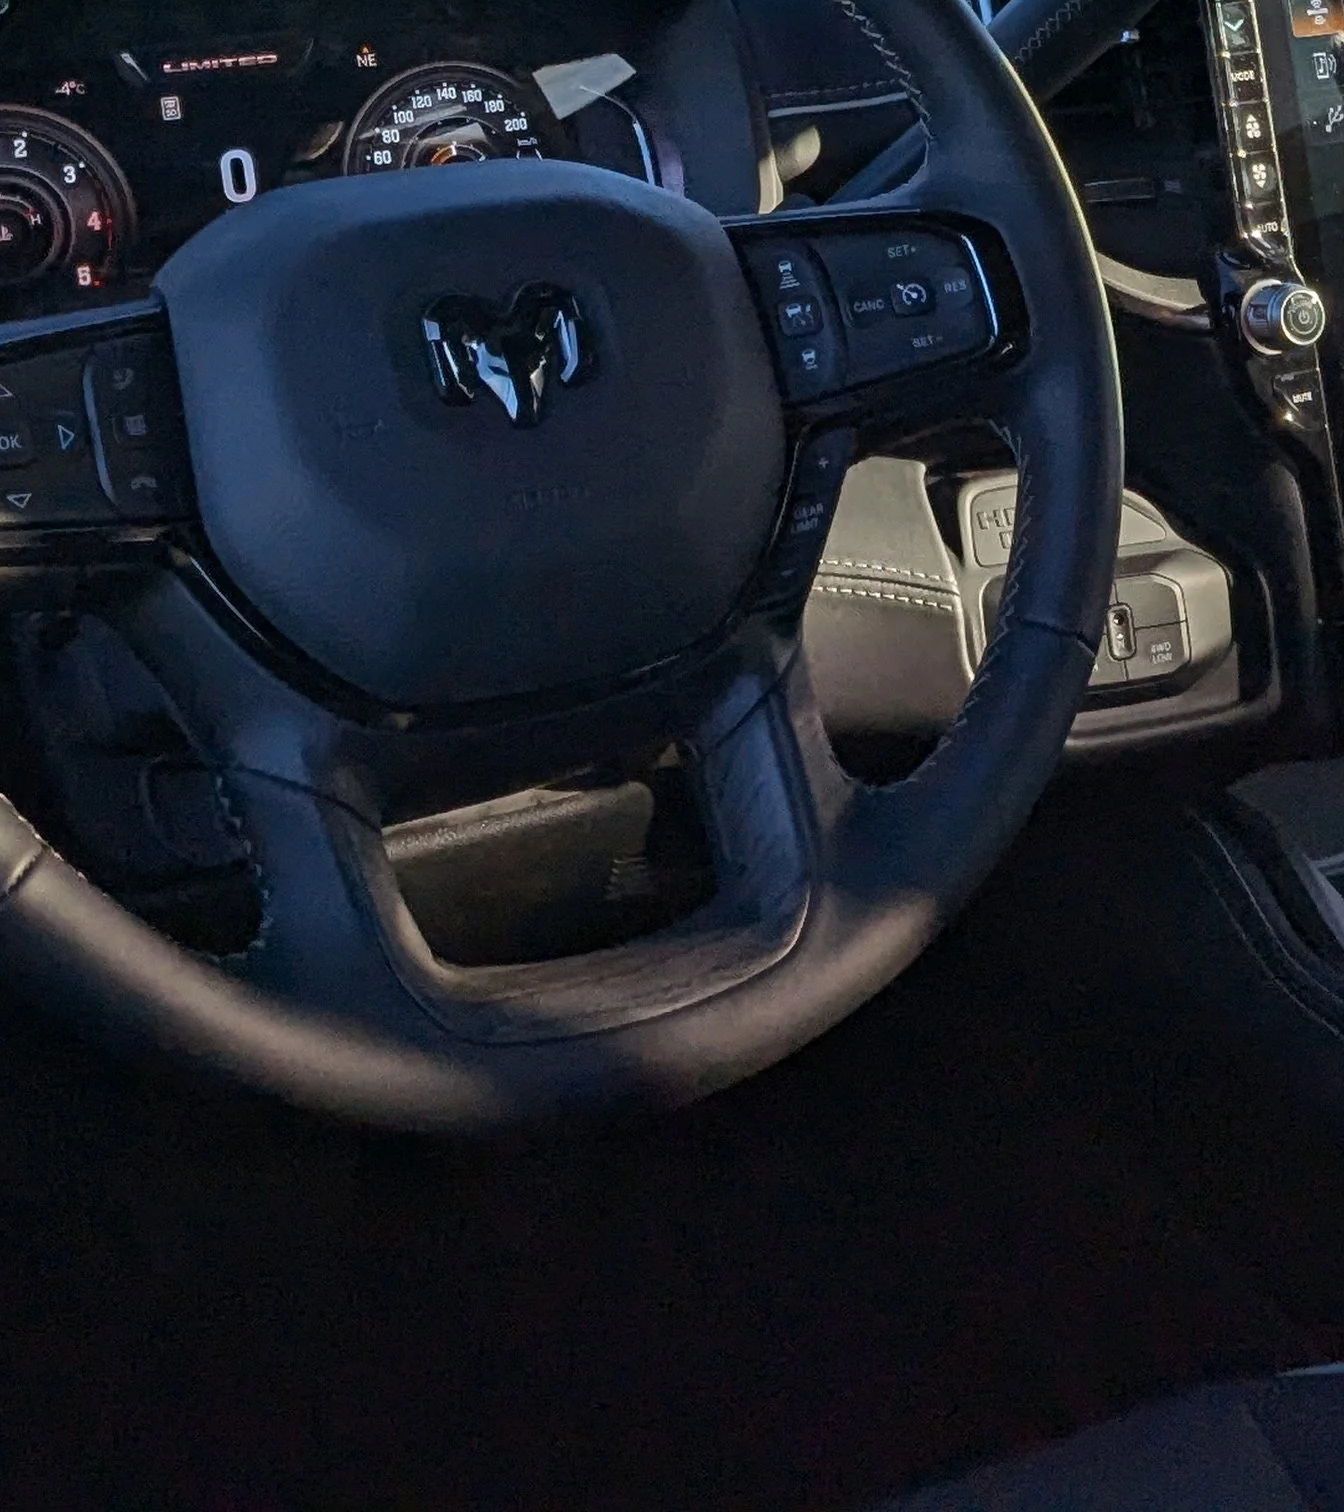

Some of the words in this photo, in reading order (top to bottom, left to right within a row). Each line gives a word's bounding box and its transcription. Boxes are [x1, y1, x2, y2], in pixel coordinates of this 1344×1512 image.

[162, 52, 279, 75] LIMITED
[355, 52, 378, 68] NE
[411, 95, 432, 110] 120
[436, 87, 457, 102] 140
[462, 89, 483, 104] 160
[484, 99, 505, 114] 180
[392, 109, 414, 125] 100
[504, 117, 528, 133] 200
[381, 128, 401, 144] 80
[13, 139, 28, 159] 2
[373, 150, 392, 166] 60
[62, 165, 77, 184] 3
[220, 148, 257, 204] 0
[86, 211, 102, 231] 4
[853, 298, 885, 314] CANC
